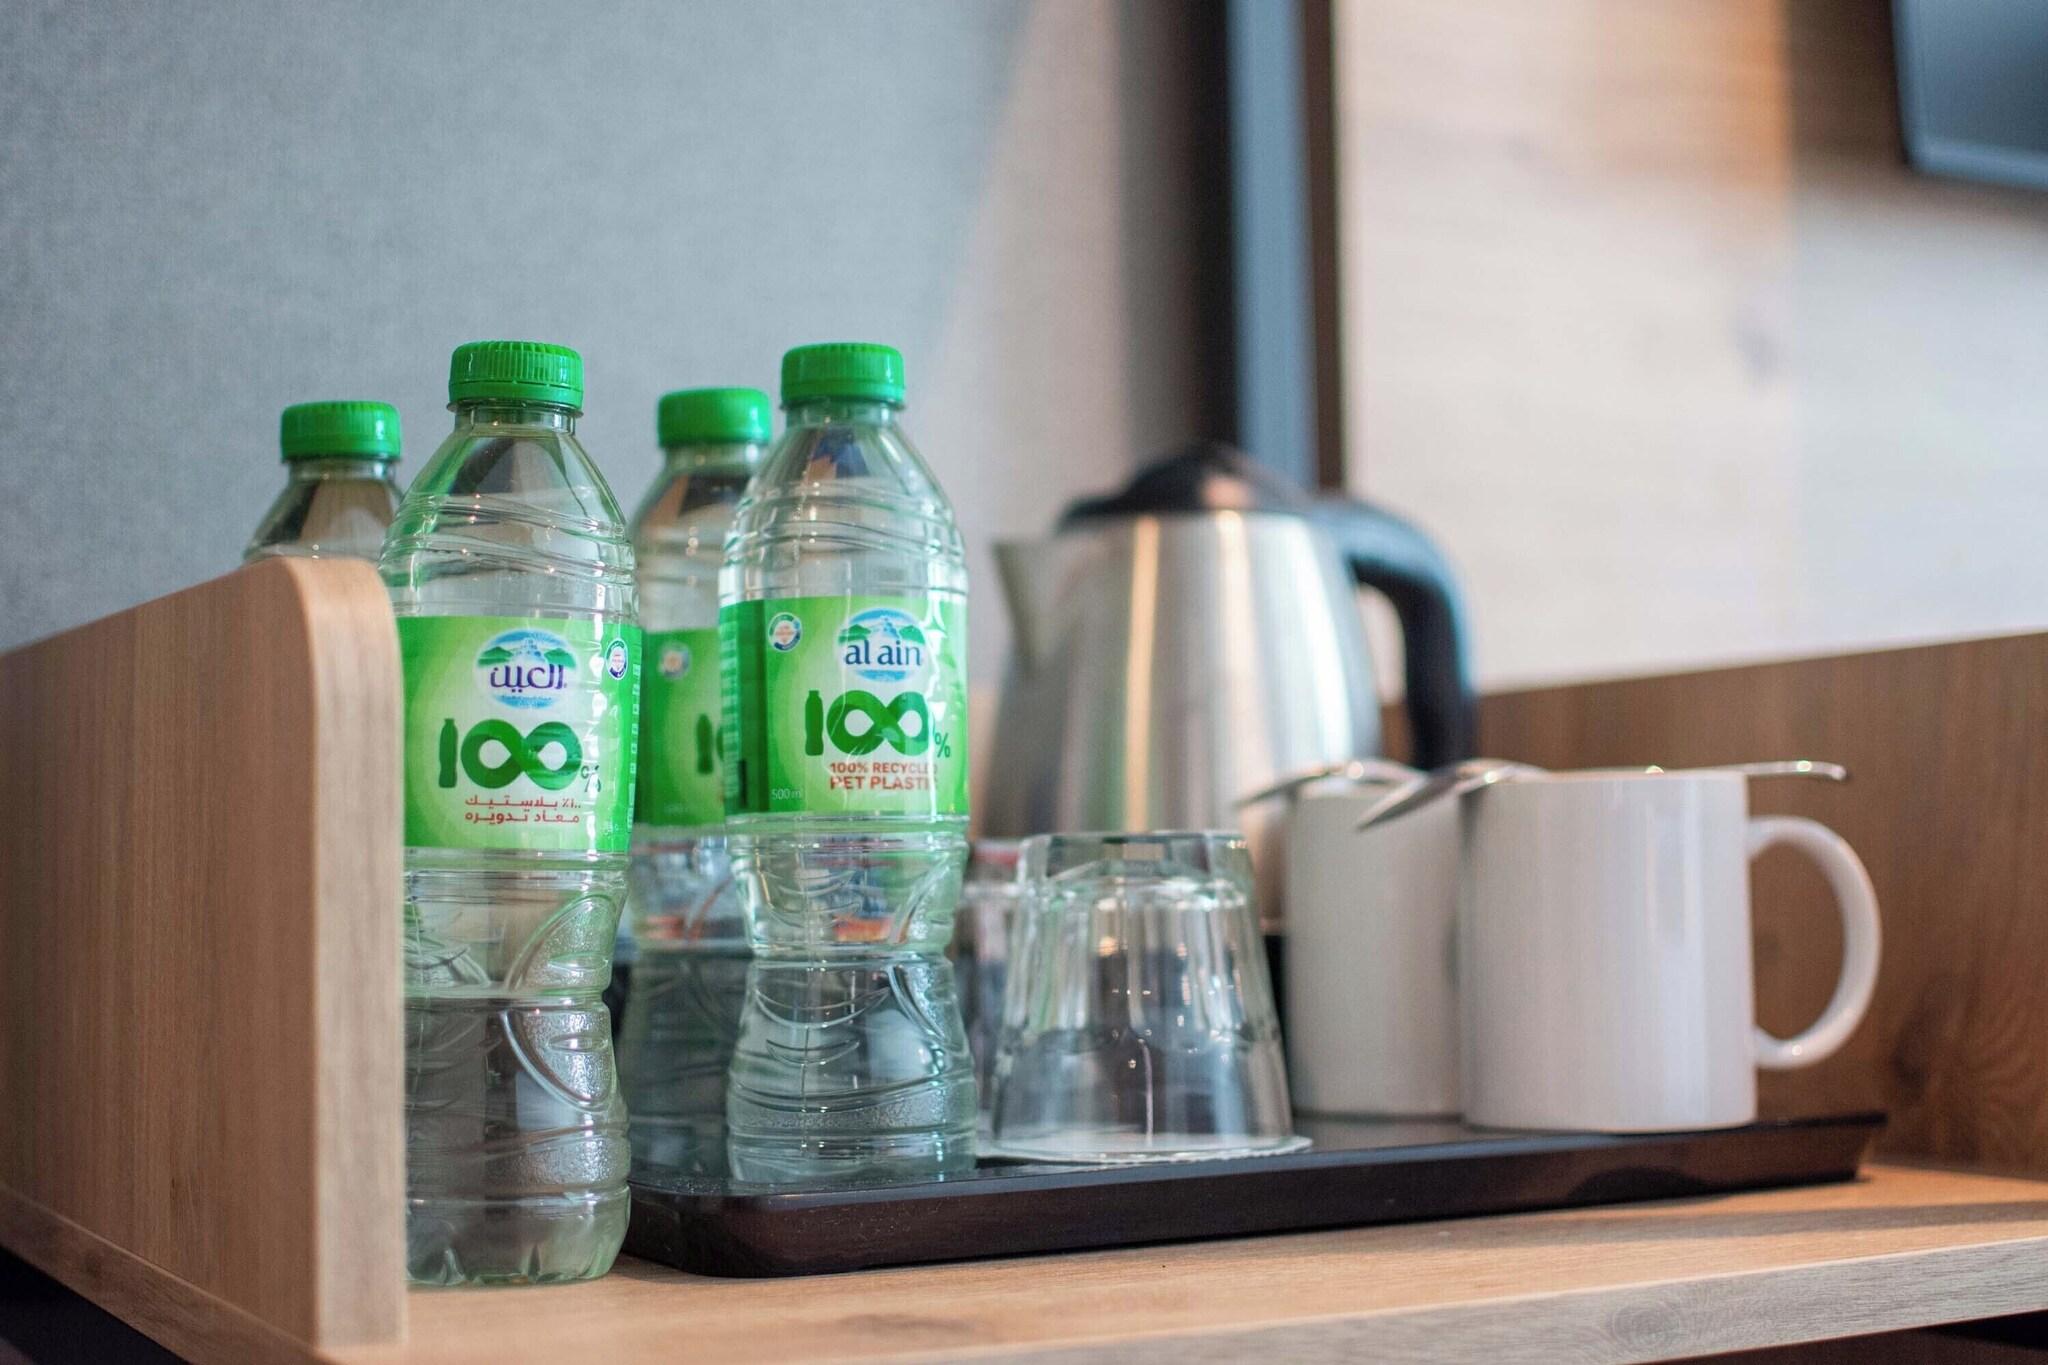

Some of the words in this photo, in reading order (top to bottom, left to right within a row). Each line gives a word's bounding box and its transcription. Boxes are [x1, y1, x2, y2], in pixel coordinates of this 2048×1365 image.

[845, 639, 871, 665] al
[877, 640, 921, 666] ain
[490, 663, 565, 693] العين
[829, 762, 868, 774] 100%
[829, 776, 866, 790] PET
